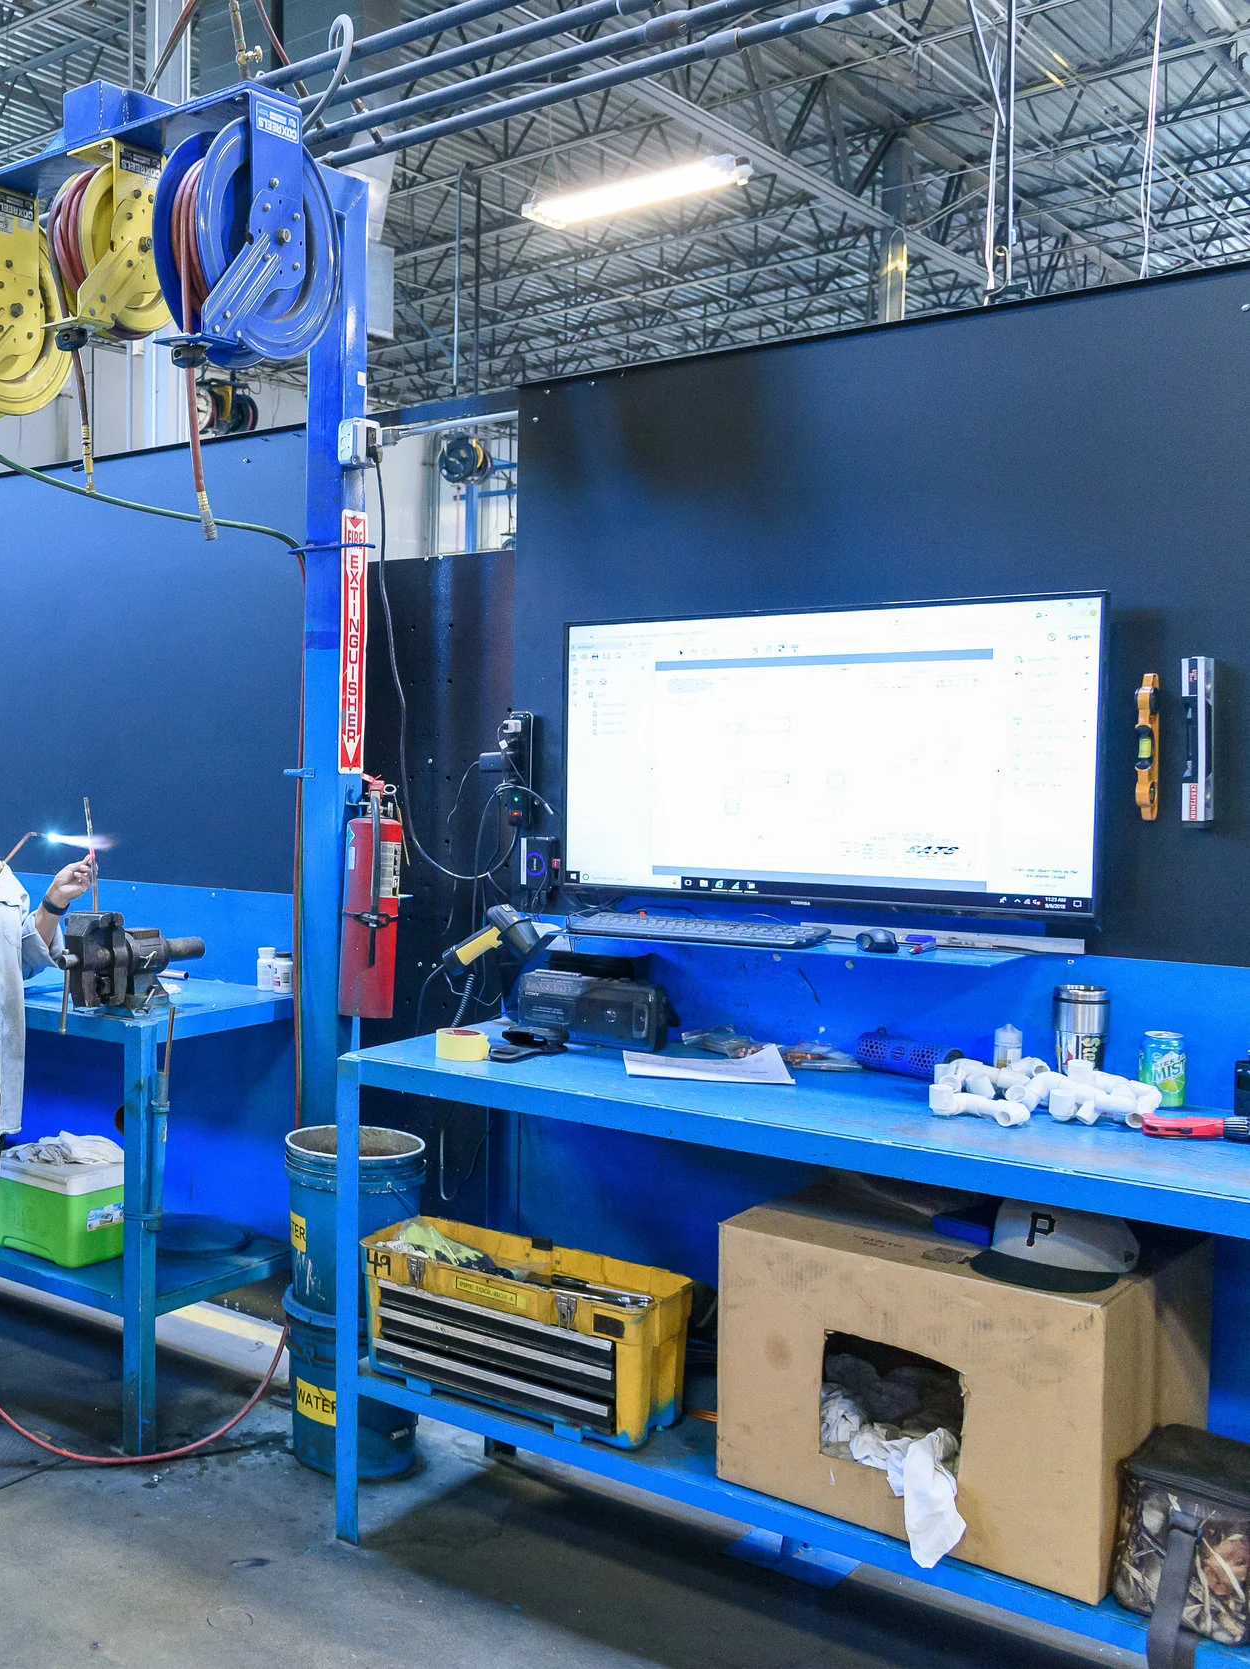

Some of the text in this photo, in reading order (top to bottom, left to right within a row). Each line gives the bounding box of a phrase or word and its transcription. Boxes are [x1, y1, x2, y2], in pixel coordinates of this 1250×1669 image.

[257, 116, 297, 141] COXREELS
[121, 158, 161, 179] COXREELS
[348, 530, 363, 550] FIRE
[347, 554, 360, 743] EXTINGUISHER
[1153, 1058, 1186, 1081] MIST
[291, 1221, 306, 1241] TER
[1026, 1211, 1057, 1247] P
[366, 1248, 391, 1276] 49
